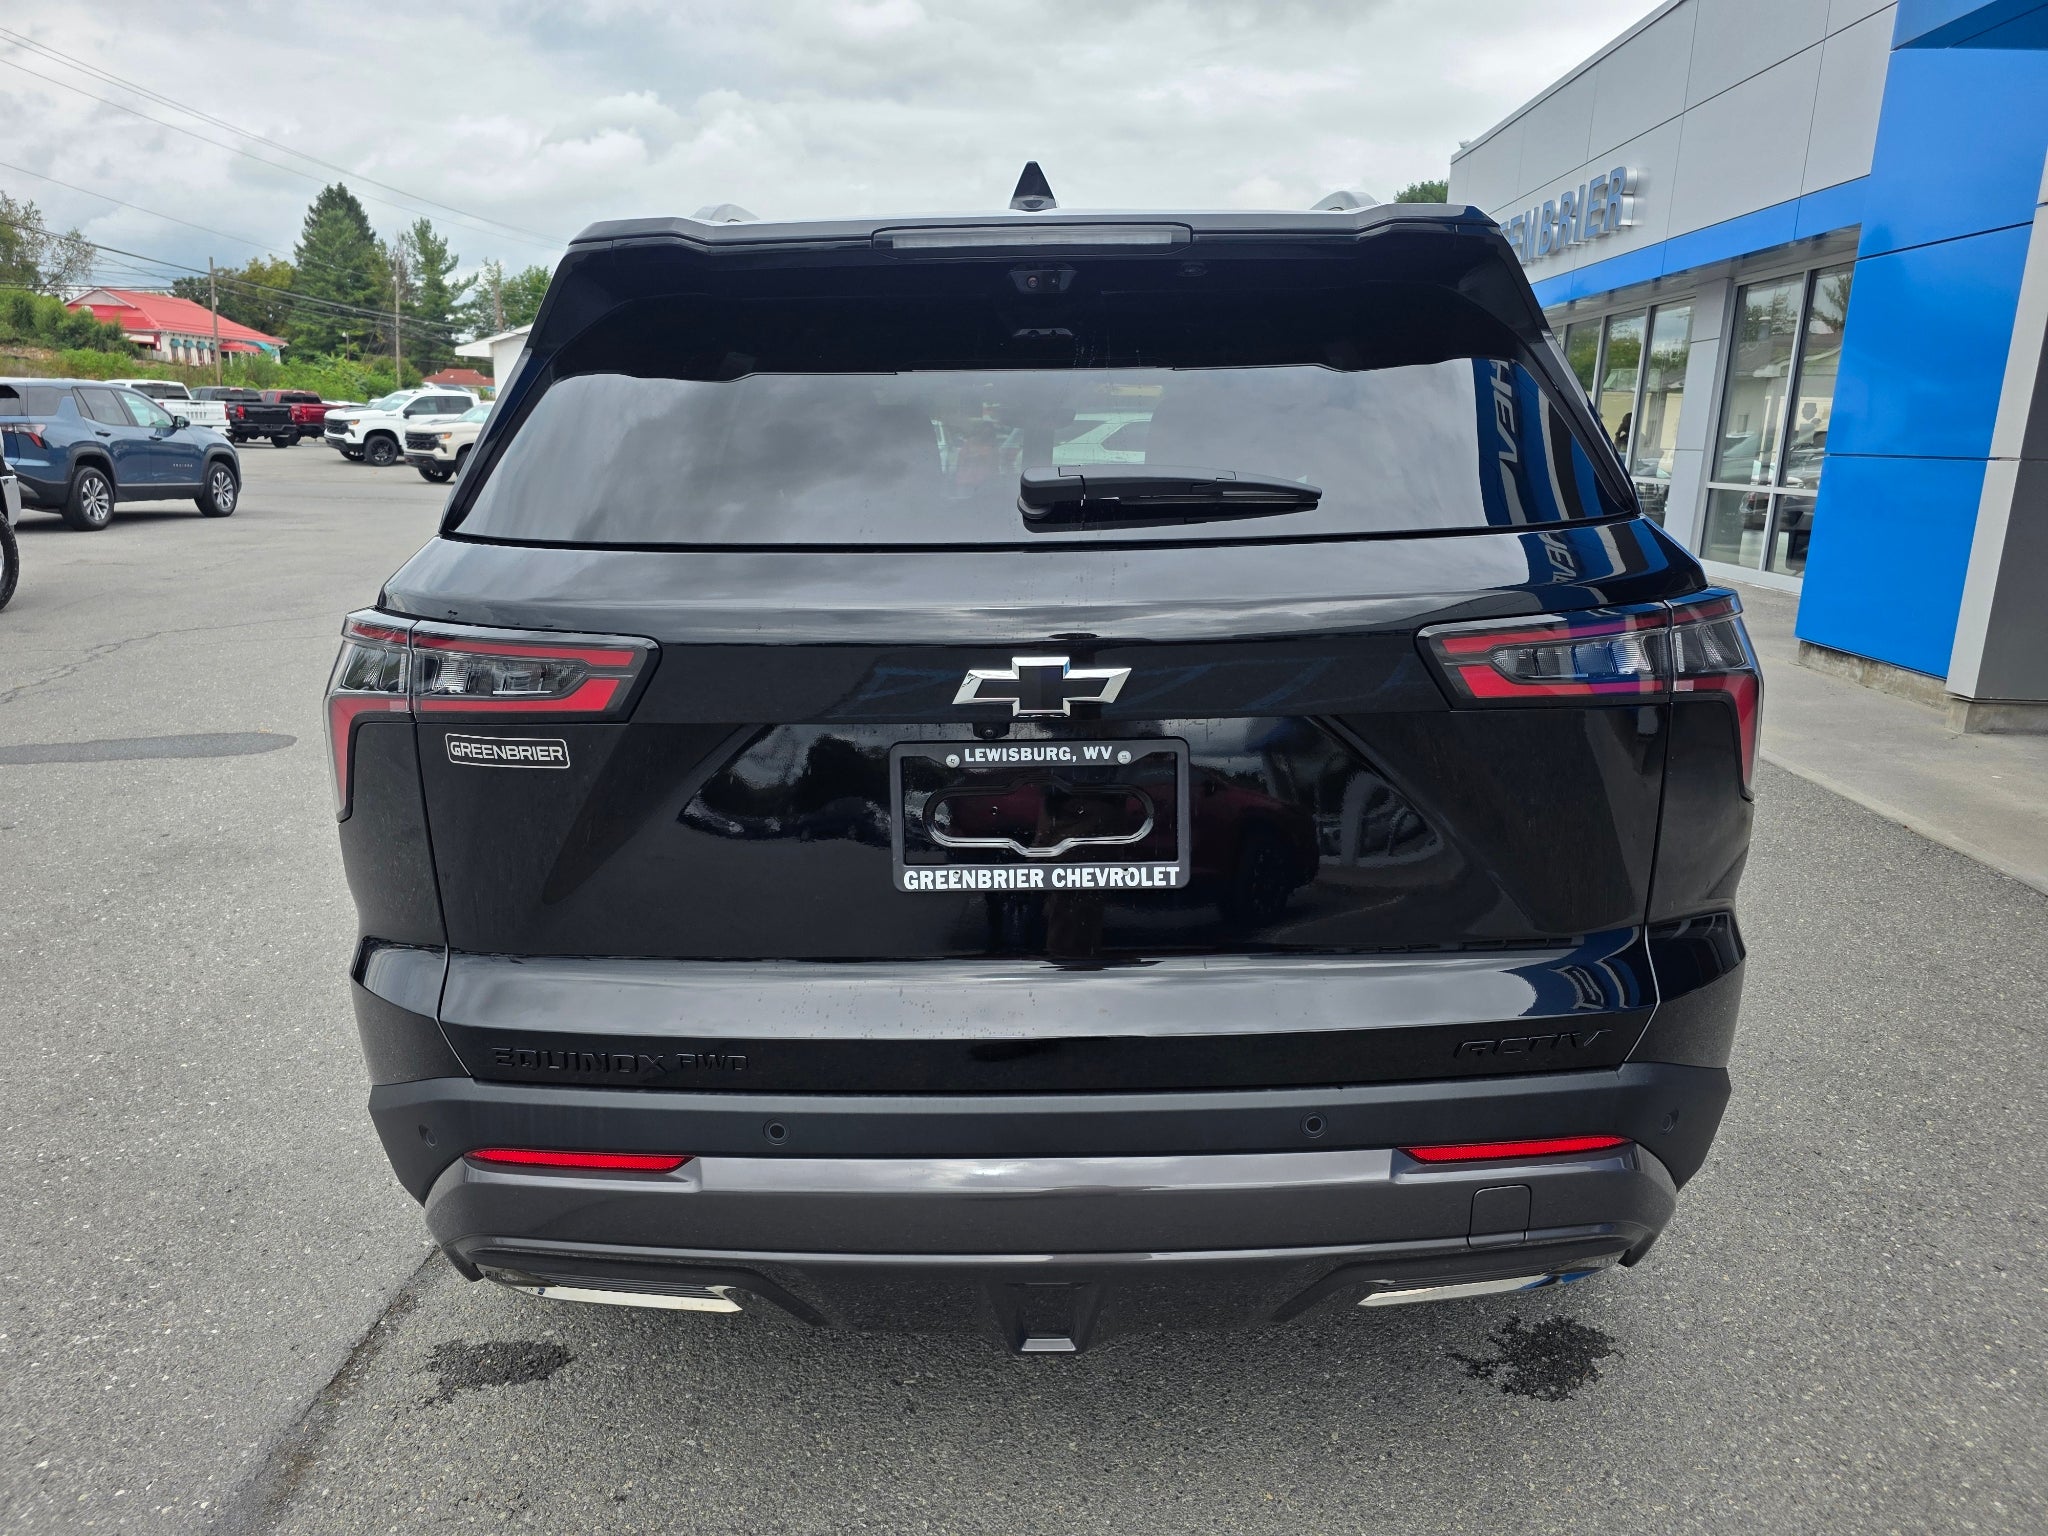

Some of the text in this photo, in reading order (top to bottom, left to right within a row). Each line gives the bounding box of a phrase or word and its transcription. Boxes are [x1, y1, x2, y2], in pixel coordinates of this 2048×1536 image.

[1500, 166, 1630, 263] ENBRIER
[450, 741, 565, 761] GREENBRIER
[964, 746, 1113, 763] LEWISBURG, WV
[903, 866, 1180, 890] GREENBRIER CHEVROLET
[493, 1047, 668, 1073] EQUINOX
